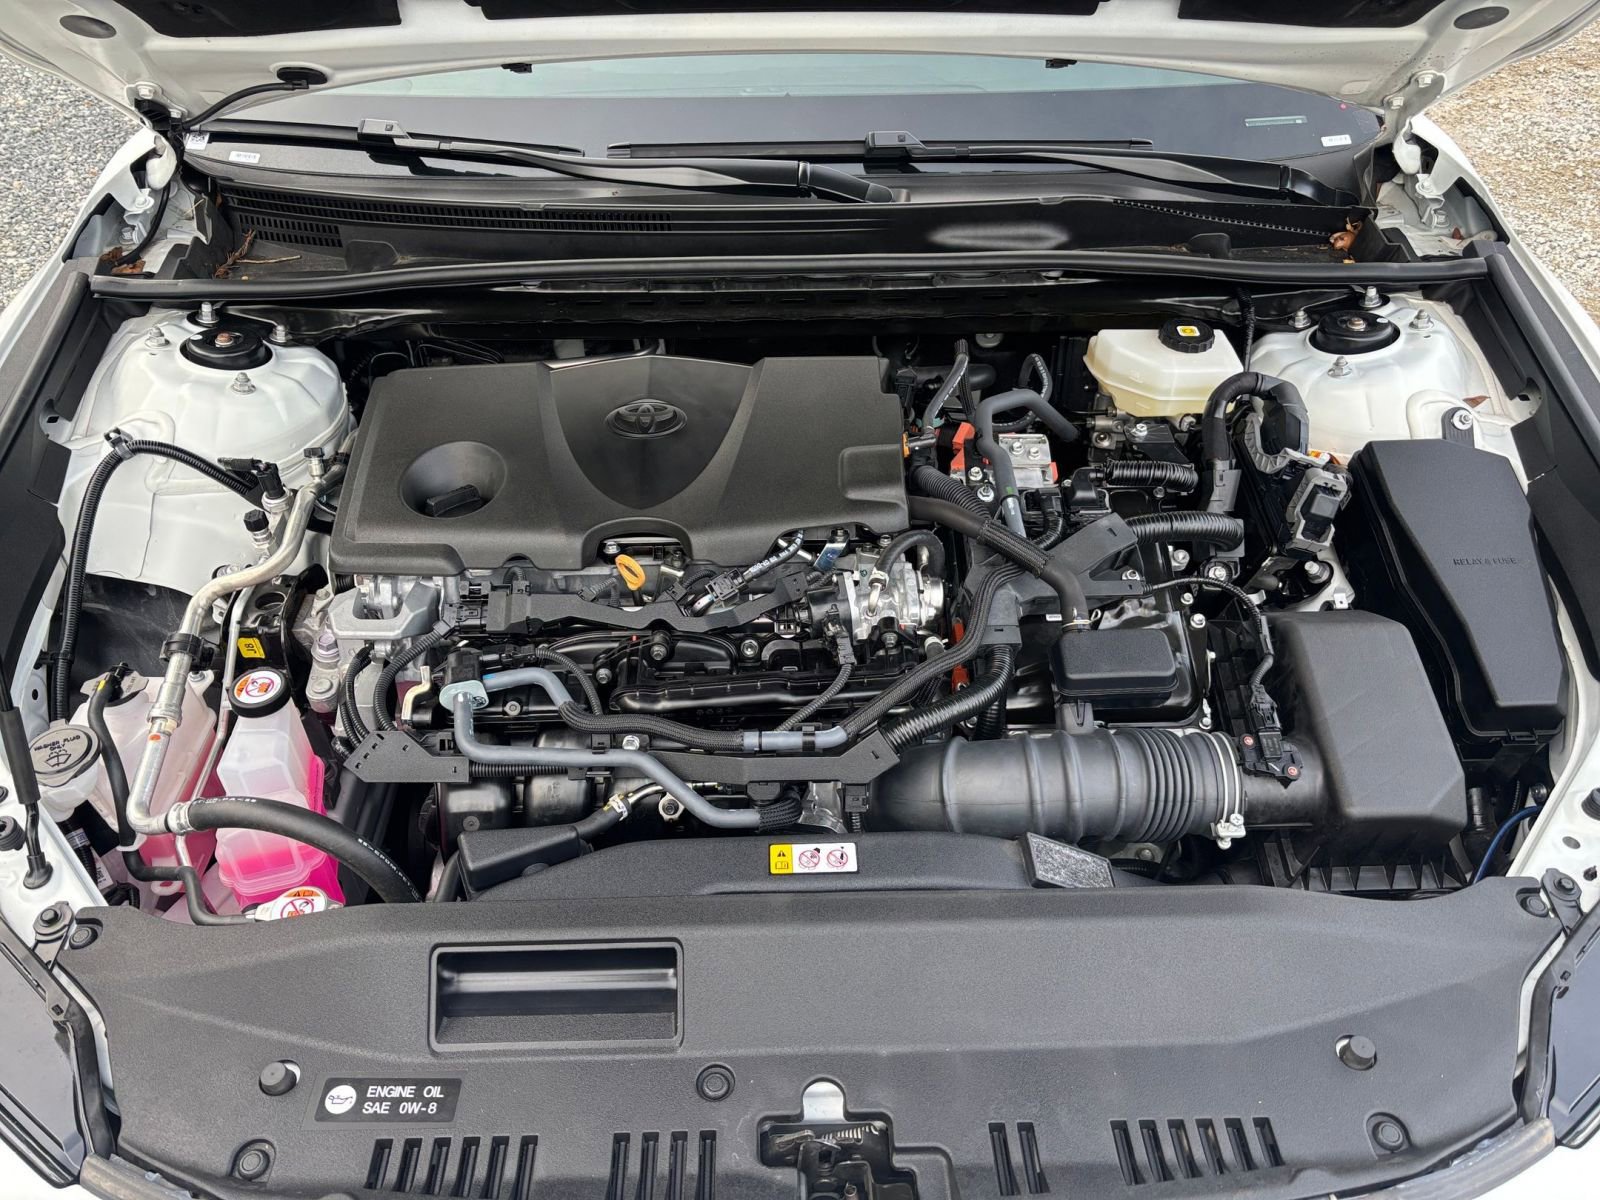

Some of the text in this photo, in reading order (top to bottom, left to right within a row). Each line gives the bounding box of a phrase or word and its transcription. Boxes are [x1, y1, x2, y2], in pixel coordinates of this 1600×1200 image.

[1453, 557, 1482, 566] RELAY
[1492, 557, 1517, 565] FUSE
[34, 734, 81, 751] WASHER FLUID
[49, 743, 65, 751] ONLY
[366, 1085, 444, 1098] ENGINE OIL
[362, 1102, 438, 1114] SAE 0W-8
